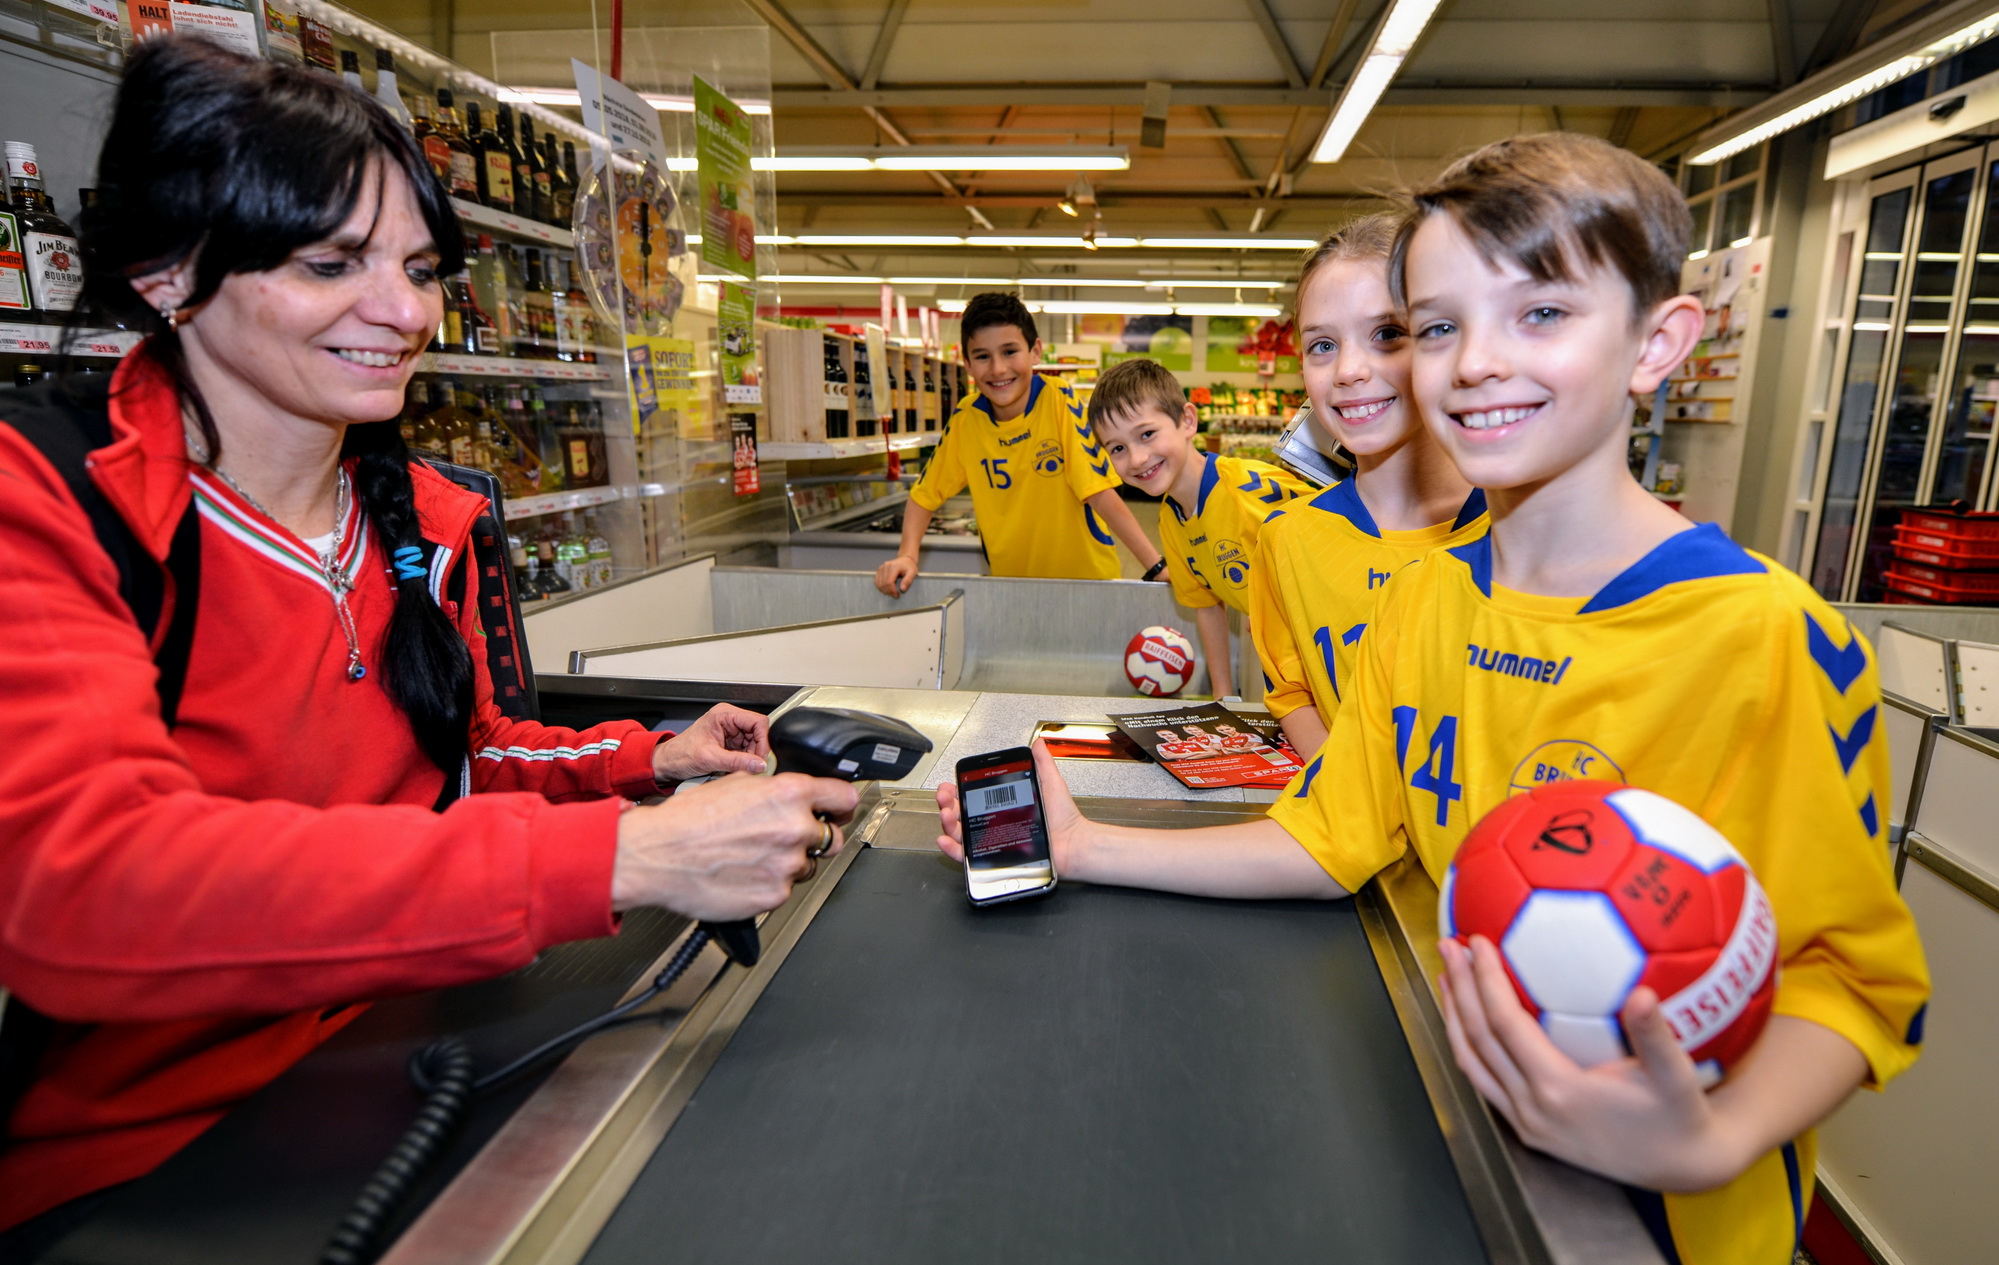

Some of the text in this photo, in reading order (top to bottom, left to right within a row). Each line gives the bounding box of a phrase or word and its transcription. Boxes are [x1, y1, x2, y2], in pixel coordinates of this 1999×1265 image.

[94, 6, 118, 22] 39.95
[139, 4, 168, 20] HALT
[173, 9, 234, 22] Ladendiebstahl
[173, 15, 194, 23] lohnt
[216, 20, 238, 29] nicht!
[36, 241, 54, 255] JIM
[23, 340, 120, 353] 21.95 21.50
[655, 350, 694, 369] SOFORT
[980, 458, 1012, 489] 15
[1144, 642, 1184, 668] RAIFFEISEN
[1392, 705, 1462, 827] 14
[1667, 893, 1773, 1043] RAIFFEISE
